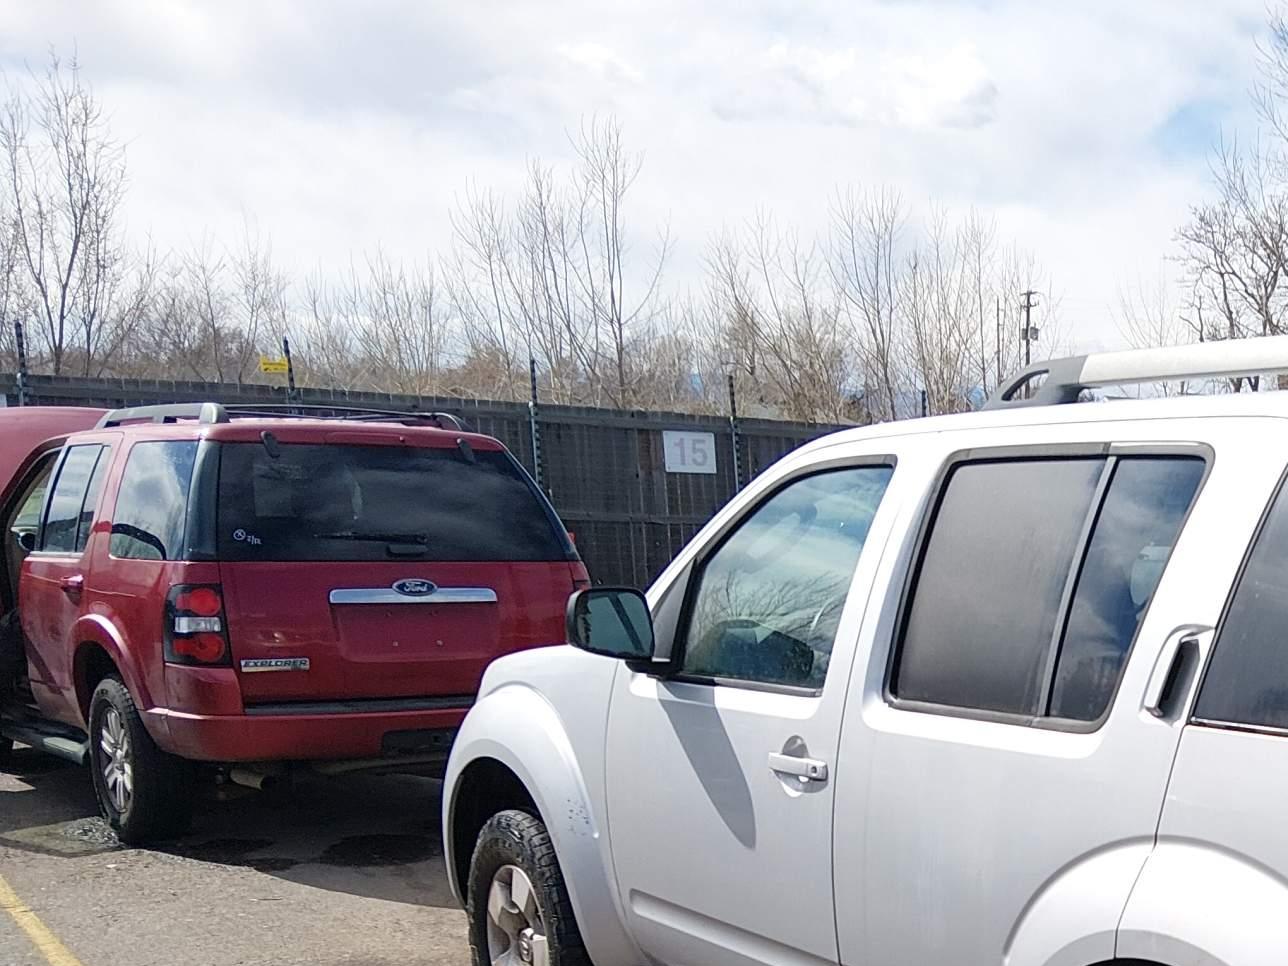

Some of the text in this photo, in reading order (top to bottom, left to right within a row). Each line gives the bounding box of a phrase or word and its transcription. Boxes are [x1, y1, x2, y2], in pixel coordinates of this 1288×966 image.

[672, 437, 708, 467] 15
[403, 581, 429, 592] Ford
[243, 659, 308, 668] EXPLORER
